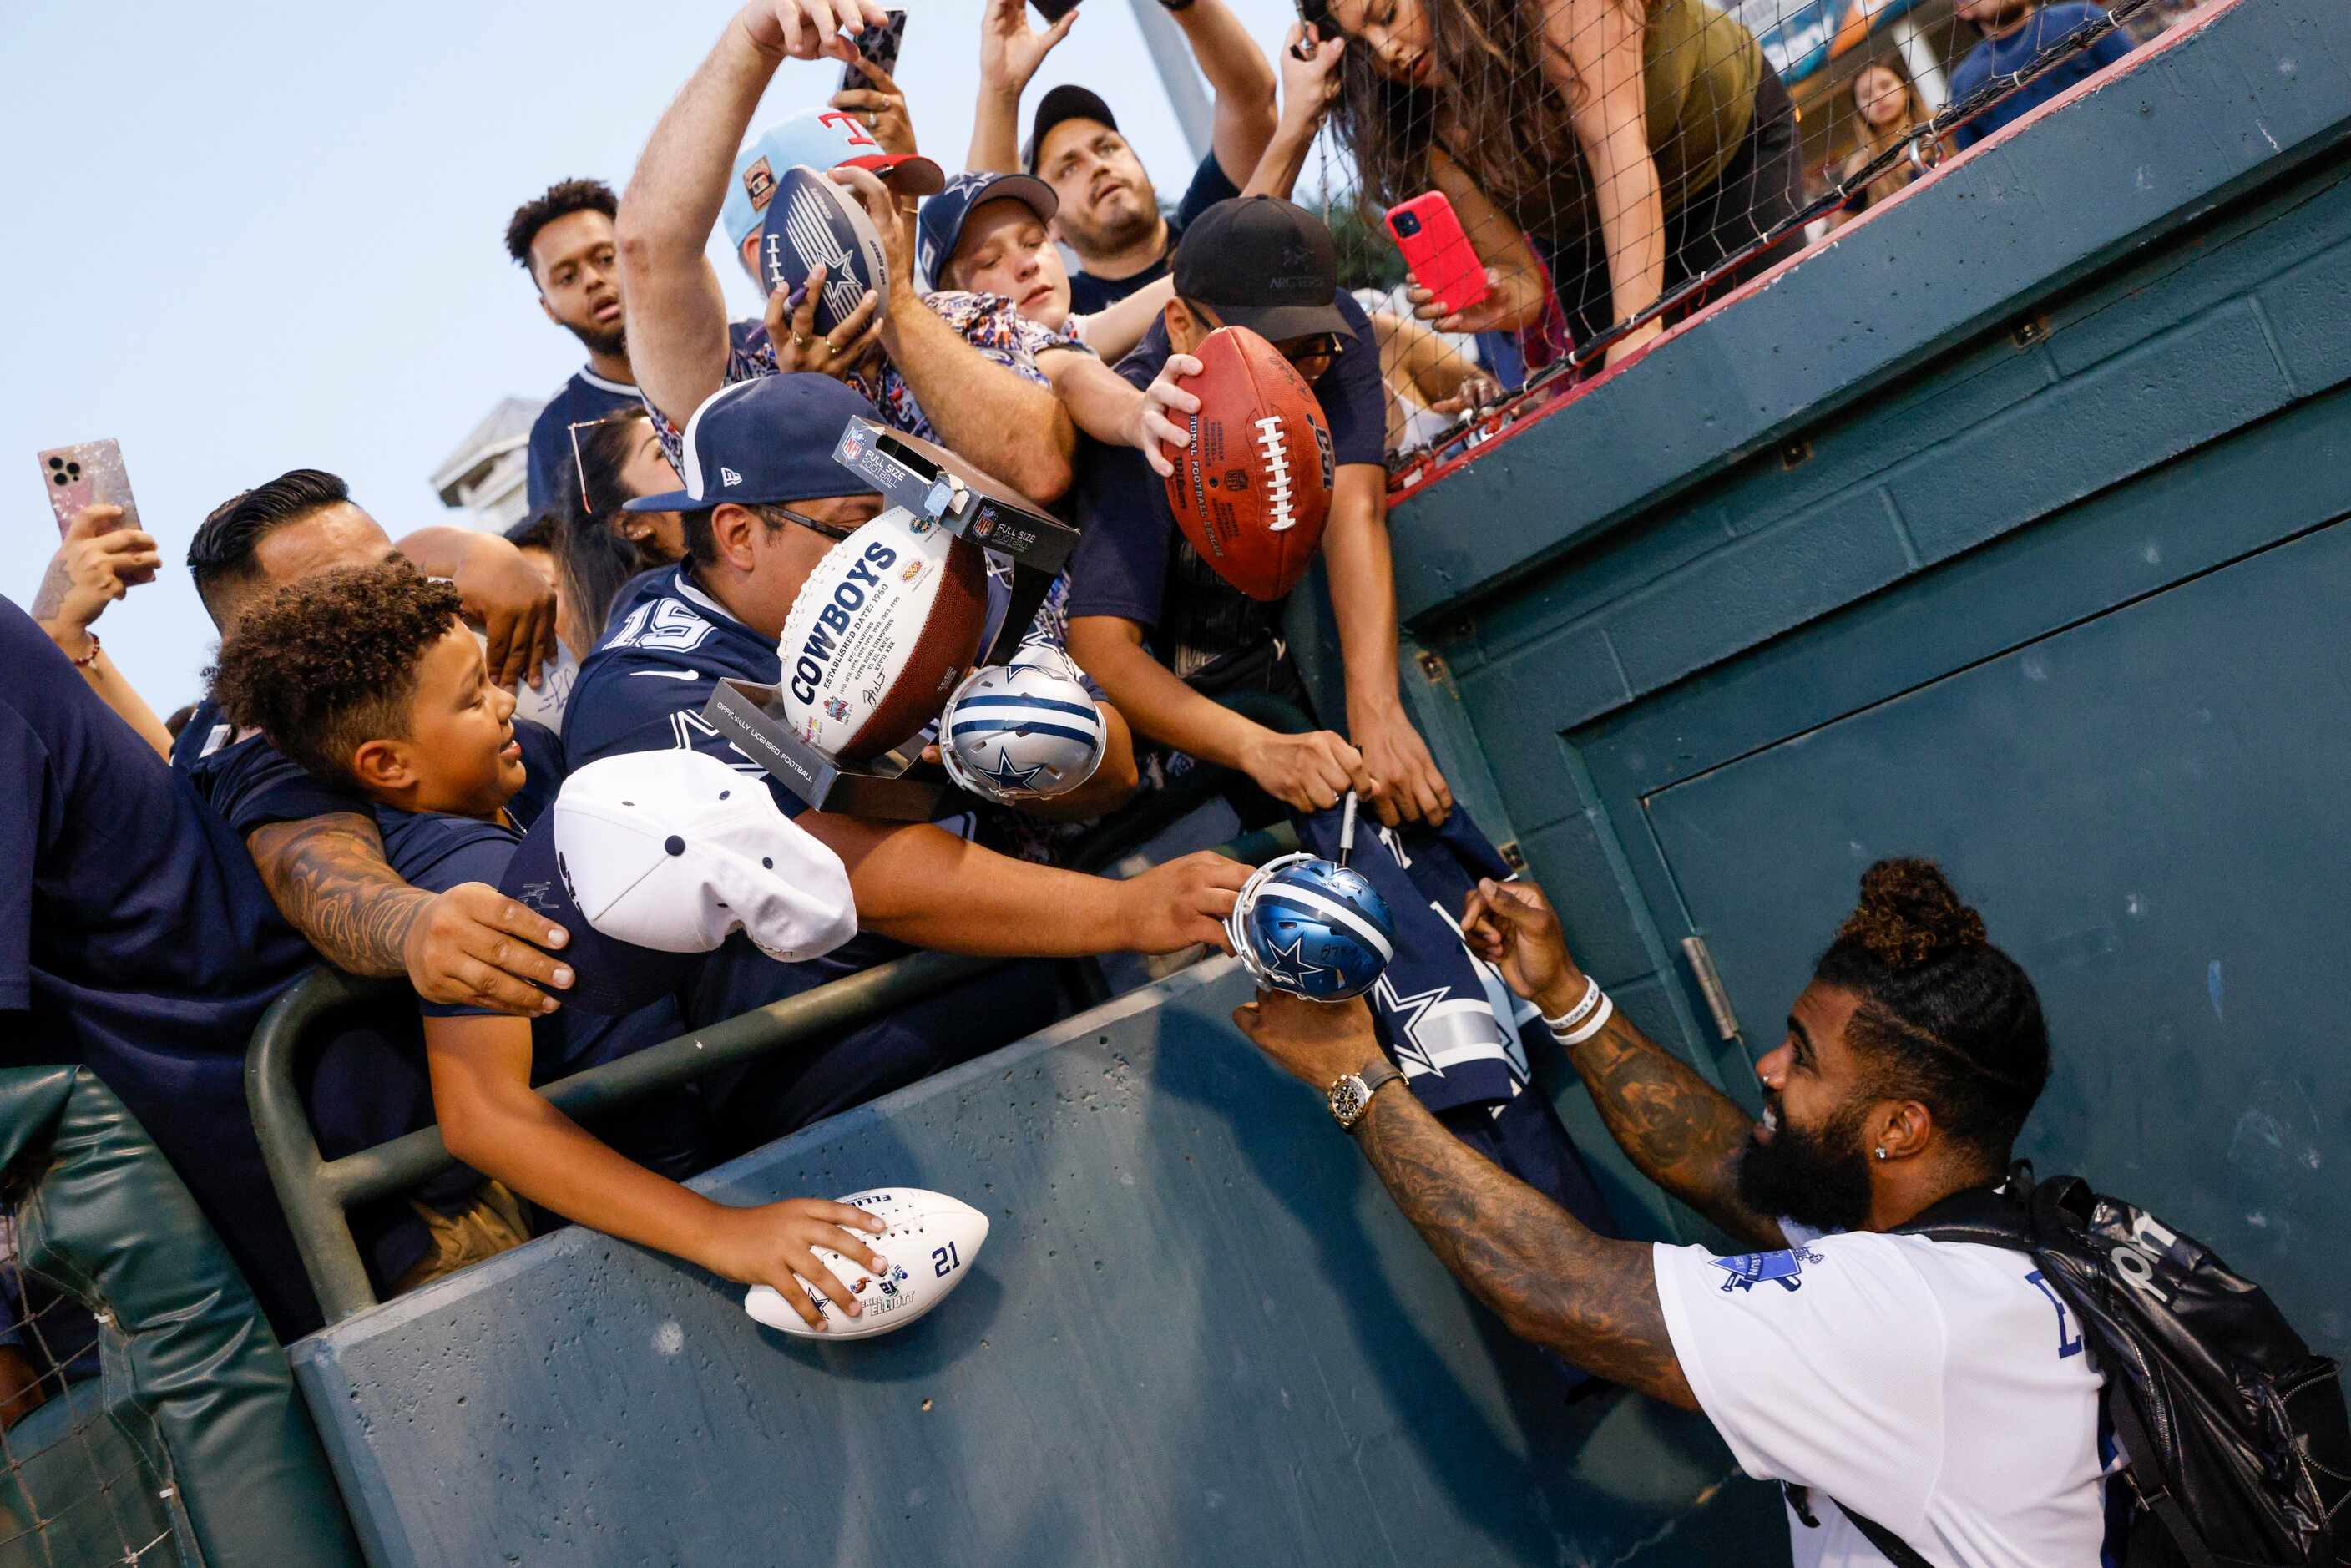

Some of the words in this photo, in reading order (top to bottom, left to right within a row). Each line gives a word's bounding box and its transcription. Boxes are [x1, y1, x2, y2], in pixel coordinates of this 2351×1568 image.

[818, 111, 876, 146] T
[861, 458, 897, 488] FOOTBALL
[865, 449, 885, 469] FULL
[886, 463, 906, 482] SIZE
[1191, 461, 1208, 517] FOOTBALL
[1204, 521, 1224, 558] LEAGUE
[993, 532, 1029, 550] FOOTBALL
[997, 523, 1015, 537] FULL
[1018, 530, 1036, 544] SIZE
[791, 541, 897, 706] COWBOYS
[824, 630, 856, 690] ESTABLISHED
[854, 604, 874, 630] DATE:
[872, 584, 888, 603] 1960
[852, 620, 874, 651] CHAMPIONS
[871, 618, 894, 649] CHAMPIONS
[717, 701, 751, 731] OFFICIALLY
[751, 728, 781, 756] LICENSED
[780, 752, 813, 783] FOOTBALL
[931, 1240, 960, 1279] 21
[870, 1290, 915, 1317] ELLIOTT
